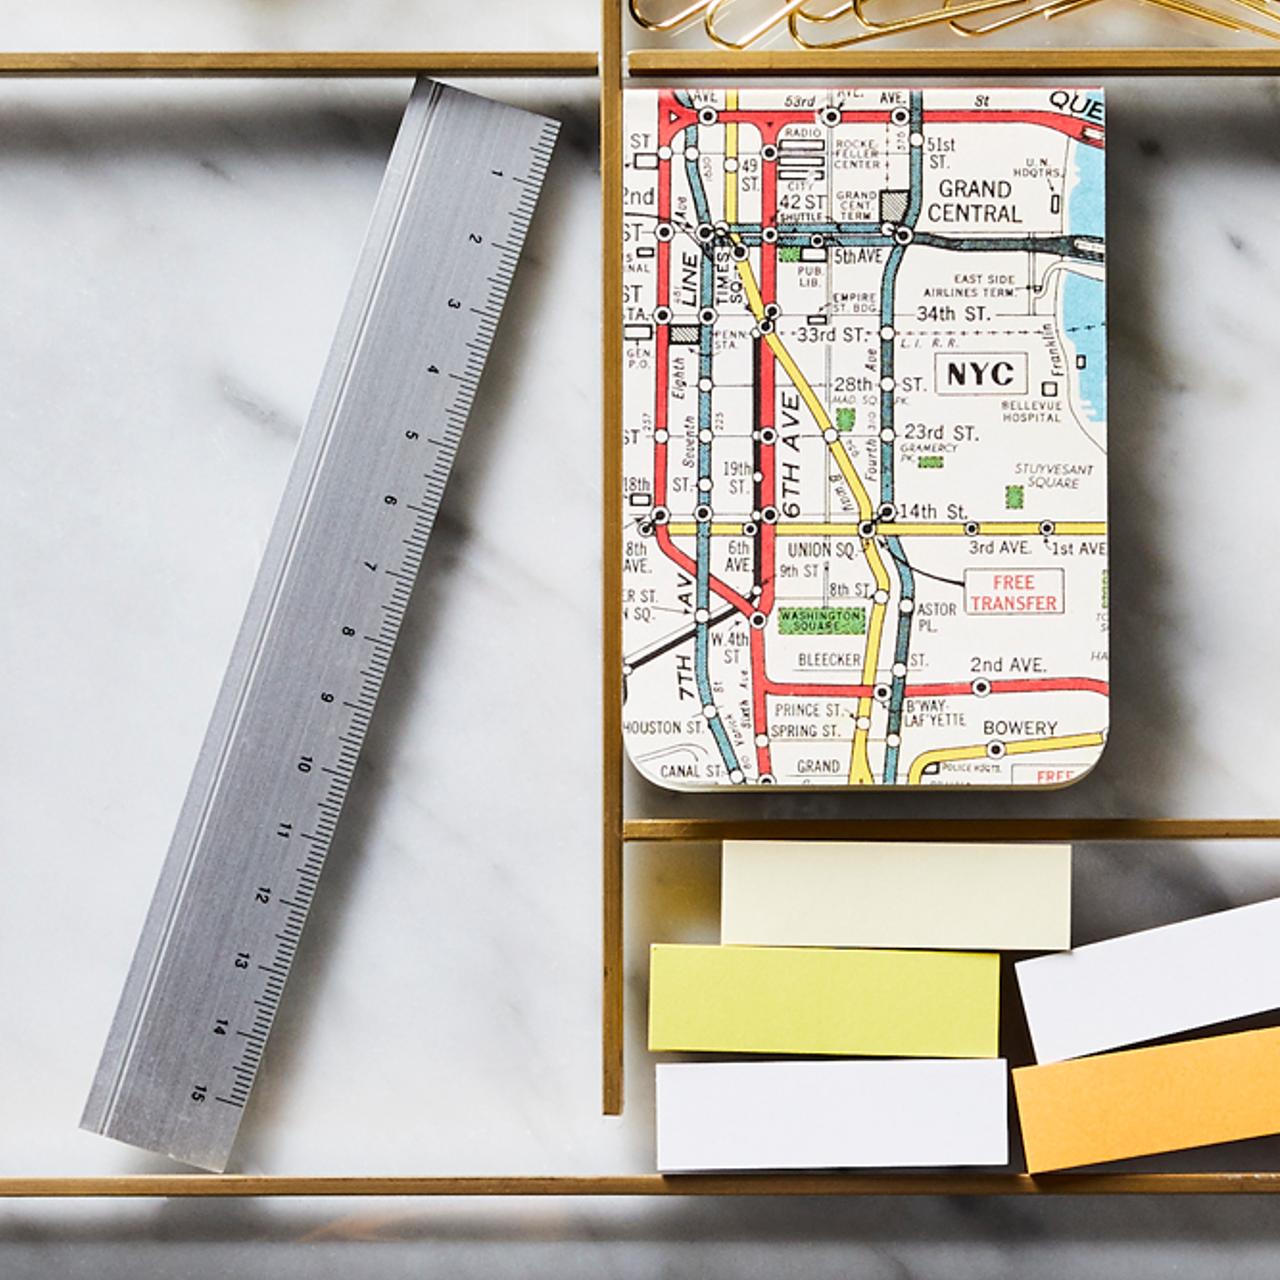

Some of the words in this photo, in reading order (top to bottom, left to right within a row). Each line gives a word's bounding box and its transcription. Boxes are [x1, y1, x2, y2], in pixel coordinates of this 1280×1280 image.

[784, 95, 816, 108] 53rd
[974, 95, 990, 107] St
[880, 91, 907, 105] AVE.
[1049, 90, 1105, 121] QUE
[785, 127, 821, 138] RADIO
[630, 133, 651, 149] ST
[927, 137, 955, 151] 51st
[836, 149, 879, 158] FELLER
[742, 158, 758, 173] 49
[834, 160, 880, 169] CENTER
[930, 155, 950, 169] ST.
[491, 168, 504, 178] 1
[742, 177, 760, 192] ST.
[788, 182, 813, 191] CITY
[939, 179, 1012, 199] GRAND
[780, 195, 801, 210] 42
[805, 195, 827, 209] ST
[836, 191, 877, 200] GRAND
[780, 212, 822, 221] SHUTTLE
[928, 204, 1023, 223] CENTRAL
[470, 233, 483, 245] 2
[682, 252, 697, 307] LINE
[716, 252, 730, 306] TIMES
[799, 278, 821, 288] LIB.
[954, 275, 982, 284] EAST
[988, 275, 1015, 284] SIDE
[833, 293, 877, 303] EMPIRE
[923, 288, 978, 297] AIRLINES
[448, 298, 462, 310] 3
[917, 306, 955, 322] 34th
[965, 306, 991, 322] ST.
[798, 327, 836, 342] 33rd
[843, 327, 868, 342] ST.
[1043, 322, 1064, 377] Franklin
[427, 364, 440, 375] 4
[947, 361, 1014, 387] NYC
[672, 358, 687, 400] Eighth
[834, 377, 872, 392] 28th
[903, 377, 927, 392] ST.
[1001, 401, 1062, 411] BELLEVUE
[782, 392, 800, 452] AVE
[1002, 413, 1061, 423] HOSPITAL
[405, 429, 419, 441] 5
[905, 424, 944, 440] 23rd
[953, 425, 979, 441] ST.
[682, 415, 695, 468] Seventh
[900, 444, 958, 453] GRAMERCY
[865, 438, 878, 482] Fourth
[724, 461, 752, 476] 19th
[1015, 463, 1094, 475] STUYVESANT
[673, 477, 693, 492] ST.
[729, 480, 750, 494] ST.
[1028, 476, 1079, 489] SQUARE
[782, 463, 800, 518] 6TH
[384, 495, 398, 507] 6
[901, 503, 937, 519] 14th
[947, 504, 968, 520] St.
[626, 541, 647, 556] 8th
[728, 540, 749, 555] 6th
[788, 542, 832, 558] UNION
[836, 542, 858, 560] SQ.
[970, 541, 994, 554] 3rd
[999, 541, 1032, 554] AVE.
[1052, 543, 1073, 555] 1st
[1080, 543, 1106, 555] AVE
[364, 560, 378, 573] 7
[780, 564, 799, 578] 9th
[804, 564, 819, 578] ST
[830, 582, 849, 597] 8th
[993, 575, 1035, 590] FREE
[640, 590, 658, 603] ST.
[677, 573, 693, 608] AV
[917, 602, 957, 617] ASTOR
[970, 596, 1057, 611] TRANSFER
[781, 611, 861, 621] WASHINGTON
[341, 626, 356, 638] 8
[794, 621, 839, 631] SQUARE
[919, 619, 937, 633] PL.
[724, 650, 740, 664] ST
[798, 653, 861, 667] BLEECKER
[910, 653, 929, 667] ST.
[971, 657, 1003, 672] 2nd
[1009, 657, 1047, 673] AVE.
[676, 655, 695, 700] 7TH
[320, 692, 335, 704] 9
[775, 703, 823, 717] PRINCE
[826, 703, 845, 717] ST.
[687, 721, 705, 734] ST.
[771, 725, 818, 738] SPRING
[822, 725, 841, 738] ST.
[983, 721, 1058, 736] BOWERY
[297, 754, 313, 774] 10
[797, 759, 841, 773] GRAND
[661, 765, 700, 778] CANAL
[276, 822, 293, 839] 11
[255, 885, 272, 905] 12
[233, 951, 251, 970] 13
[213, 1018, 229, 1037] 14
[191, 1083, 208, 1103] 15
